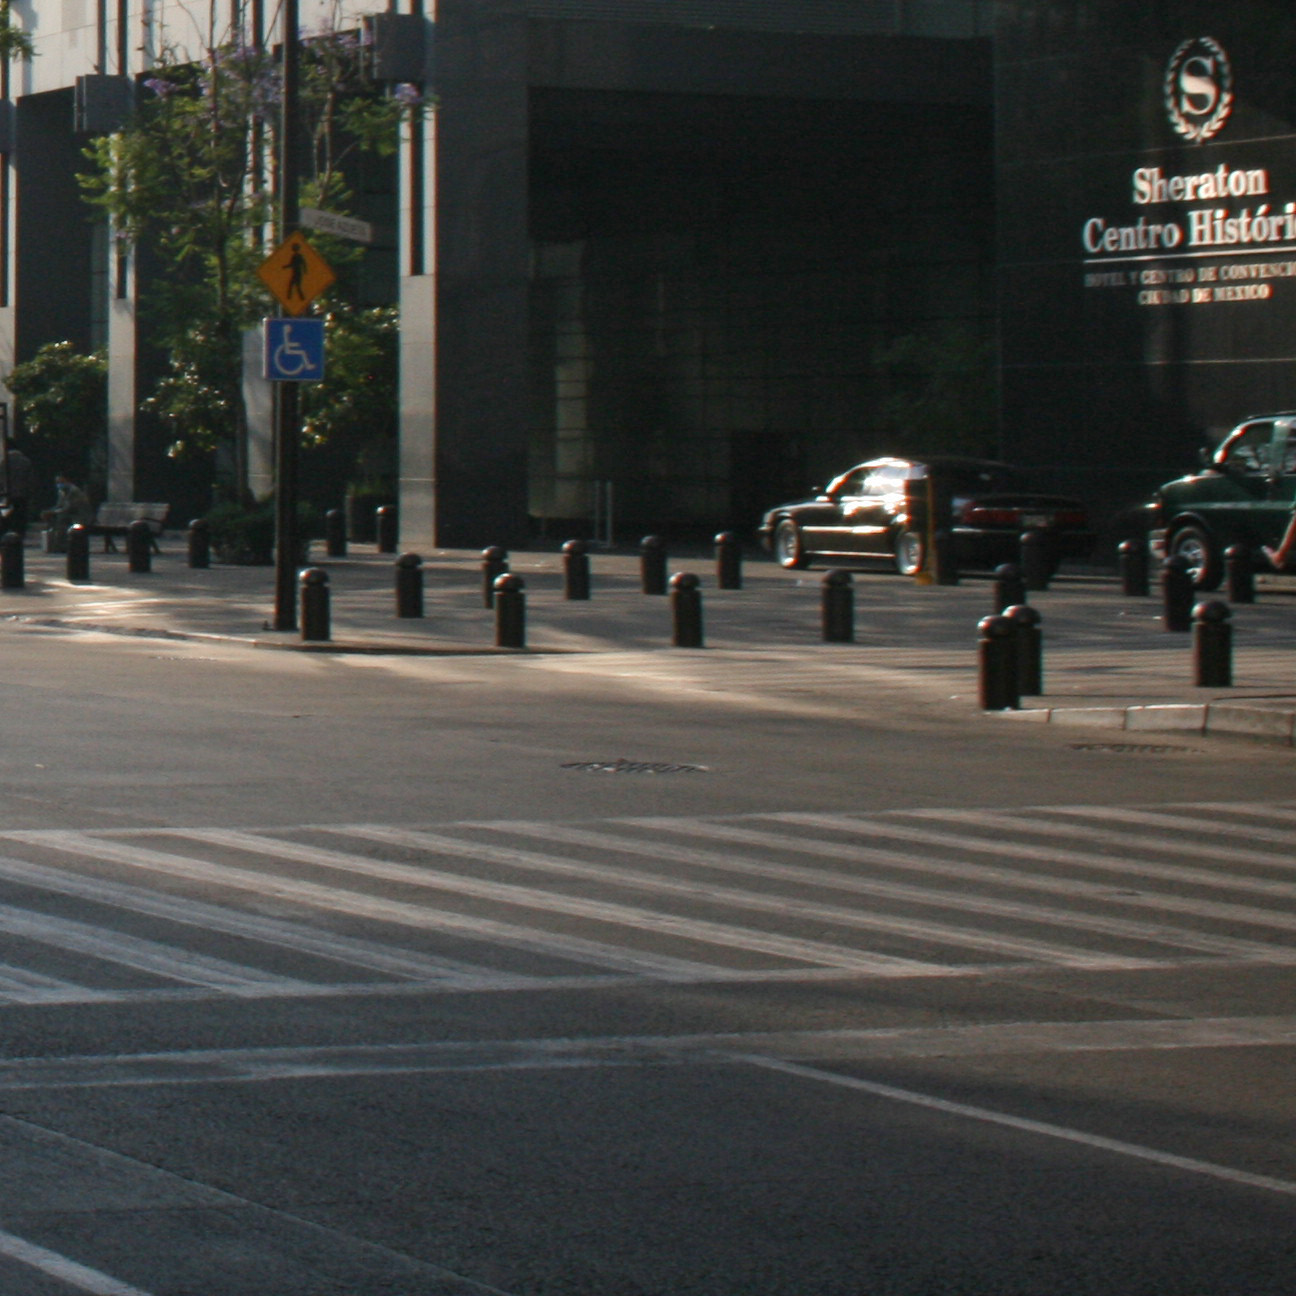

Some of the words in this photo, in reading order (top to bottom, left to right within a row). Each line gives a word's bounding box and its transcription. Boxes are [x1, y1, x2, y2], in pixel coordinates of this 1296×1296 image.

[1132, 163, 1269, 204] Sheraton
[1082, 217, 1182, 253] Centro
[1188, 203, 1296, 246] Históri
[1140, 267, 1195, 285] CENTRO
[1197, 266, 1217, 282] DE
[1219, 261, 1296, 281] CONVENCI
[1138, 288, 1190, 305] CIUDAD
[1192, 287, 1212, 303] DE
